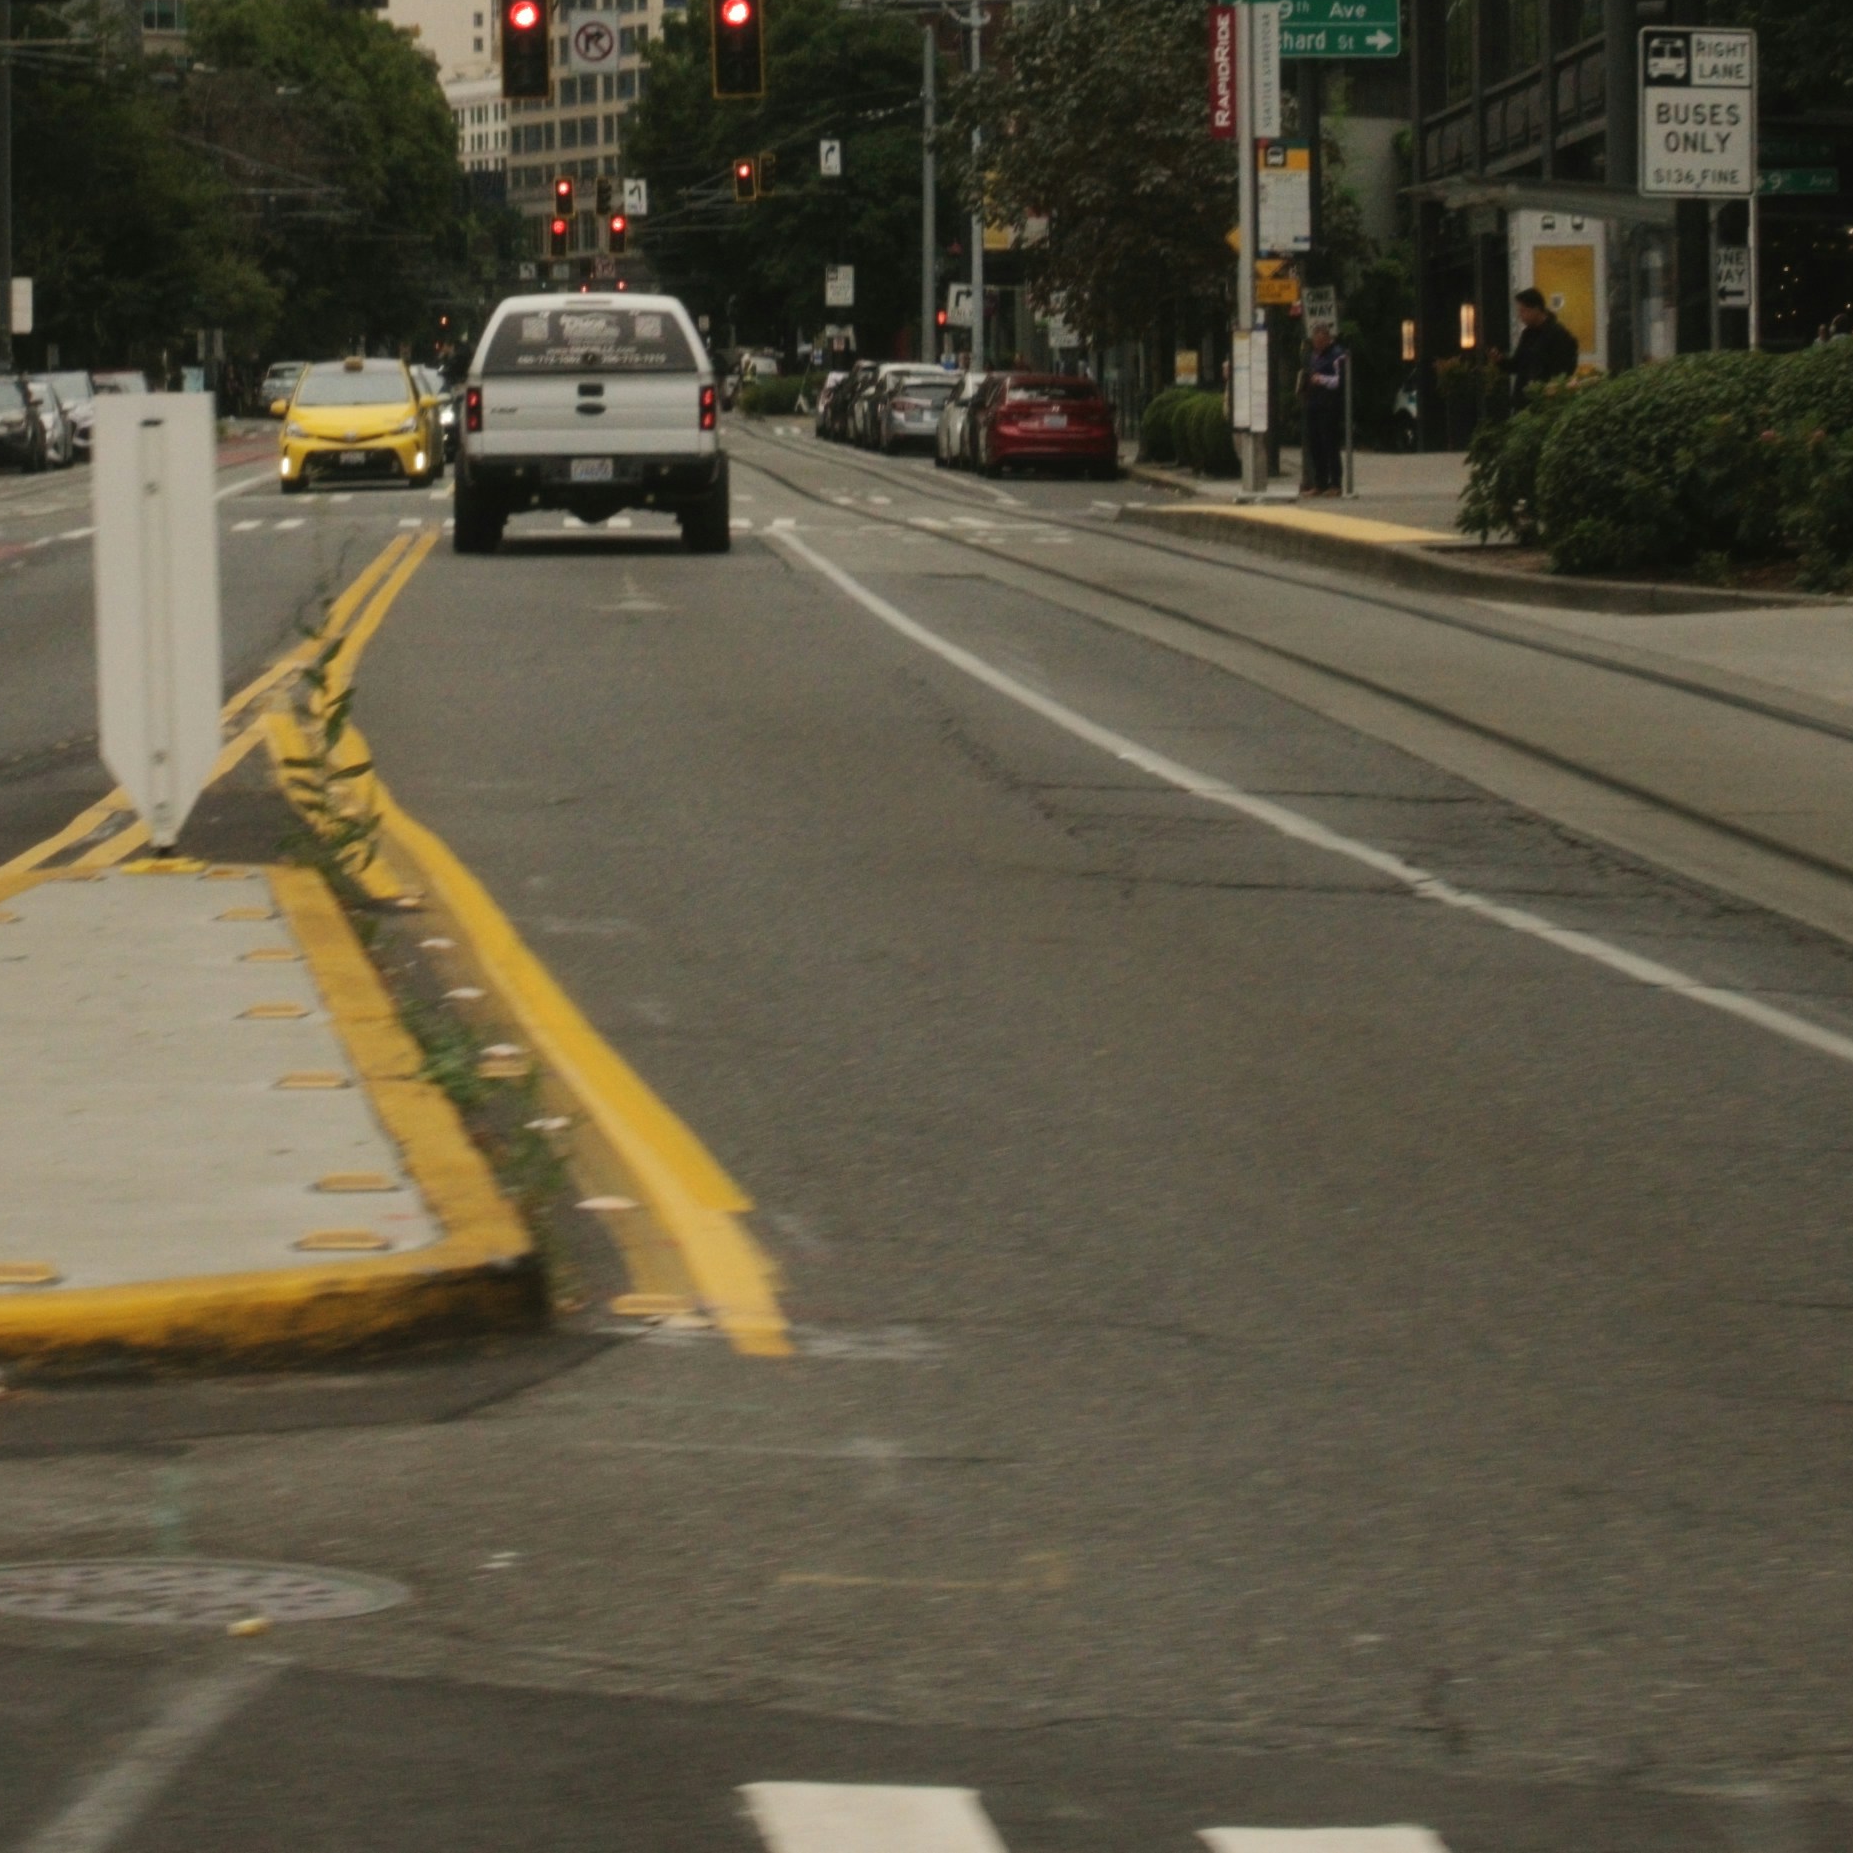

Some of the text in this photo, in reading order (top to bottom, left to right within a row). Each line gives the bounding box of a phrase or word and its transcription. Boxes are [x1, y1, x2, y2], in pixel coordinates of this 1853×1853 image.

[1328, 2, 1367, 19] Ave
[1337, 34, 1355, 50] St
[1696, 38, 1748, 58] RIGHT
[1699, 62, 1746, 79] LANE
[1656, 103, 1740, 127] BUSES
[1665, 132, 1731, 154] ONLY
[1700, 168, 1740, 184] FINE
[1308, 304, 1333, 317] WAY
